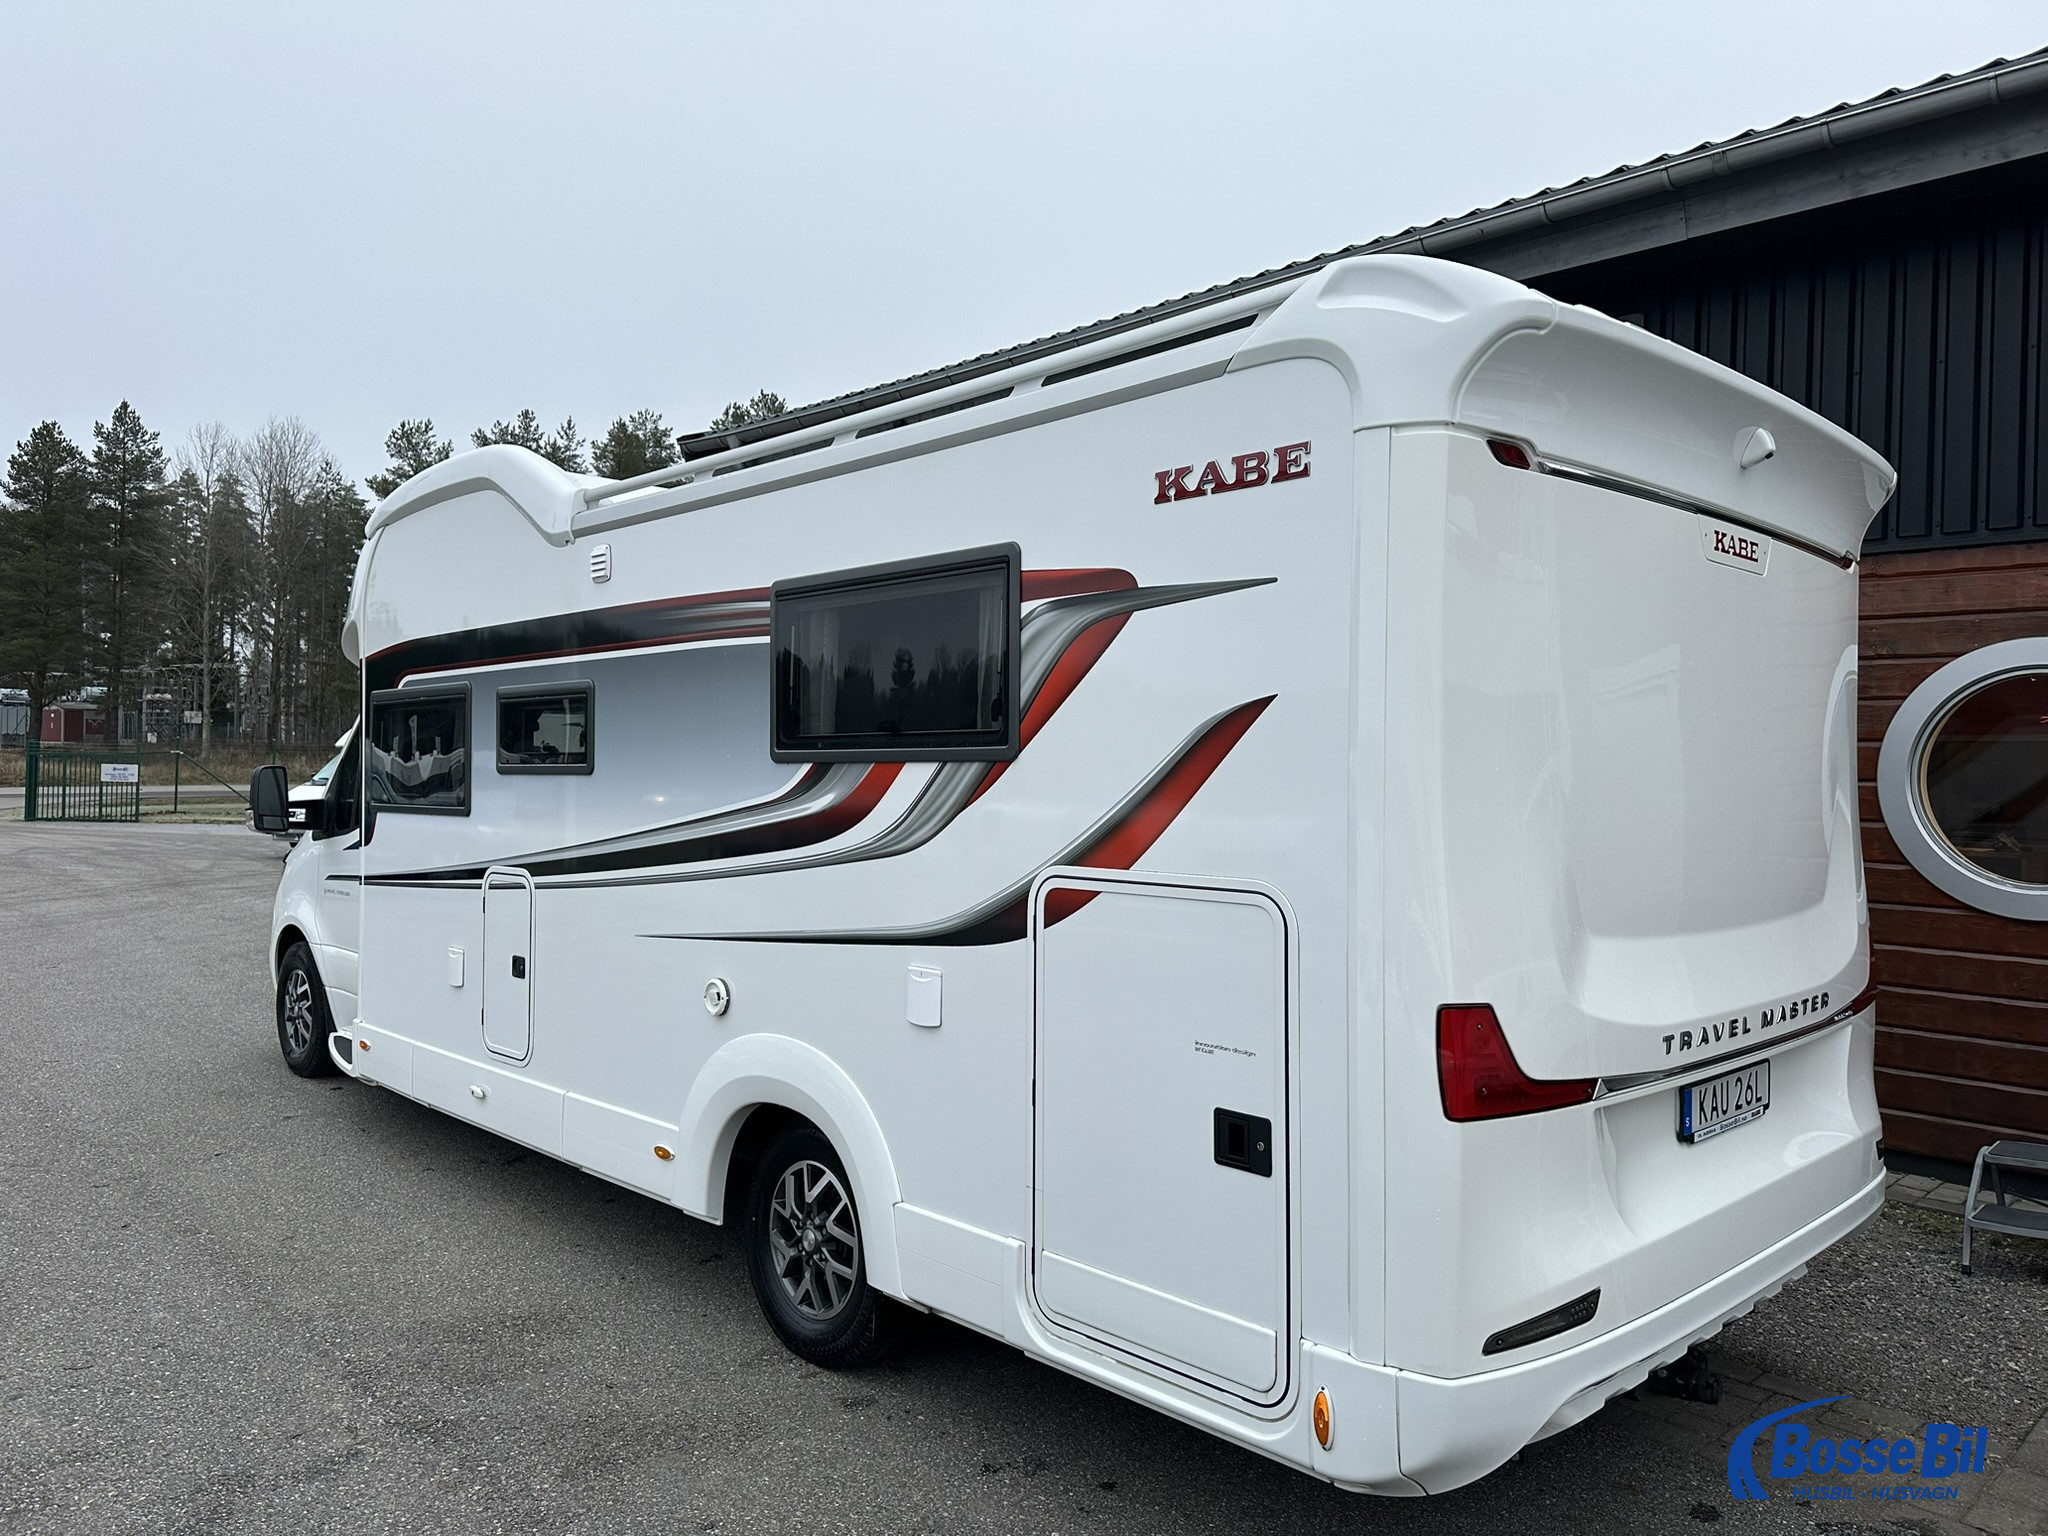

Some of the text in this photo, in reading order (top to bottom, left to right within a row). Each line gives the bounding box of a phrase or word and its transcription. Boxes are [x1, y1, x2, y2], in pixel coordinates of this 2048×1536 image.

[1154, 440, 1311, 505] KABE
[1714, 529, 1759, 563] KABE
[1662, 991, 1830, 1055] TRAVEL MASTER
[1685, 1117, 1690, 1127] S
[1699, 1070, 1763, 1126] KAU 26L
